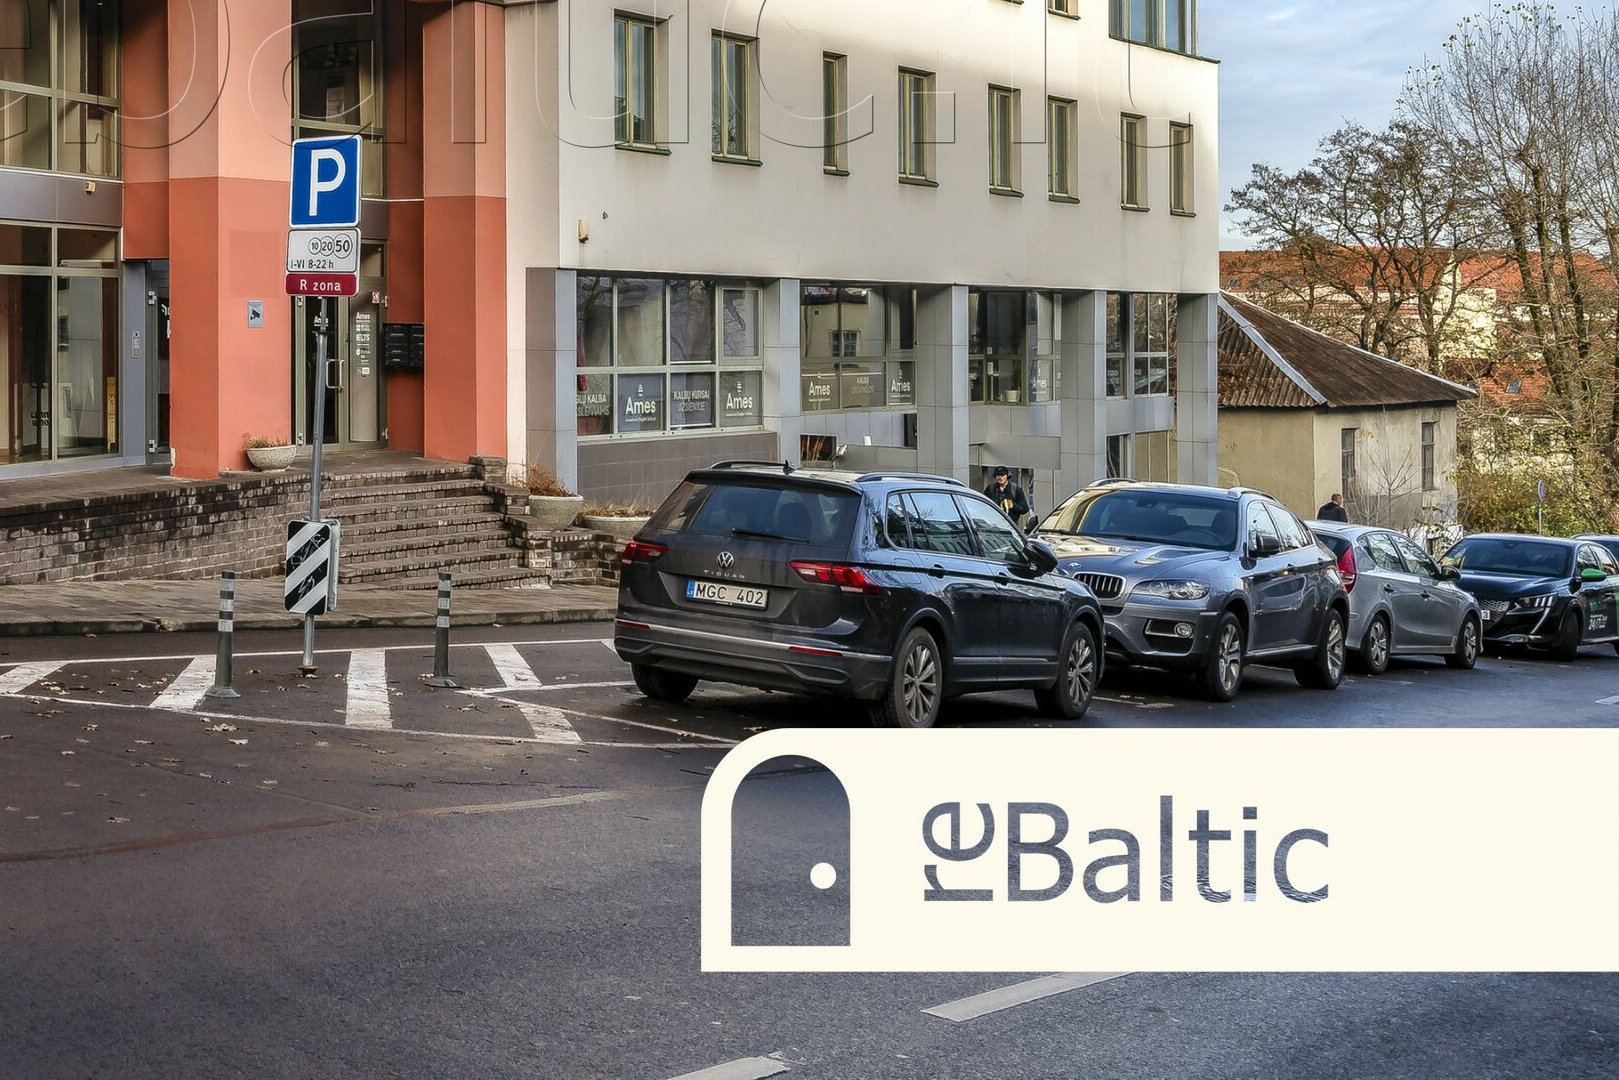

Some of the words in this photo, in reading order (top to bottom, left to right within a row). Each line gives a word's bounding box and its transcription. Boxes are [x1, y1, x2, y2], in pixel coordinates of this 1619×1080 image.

[309, 148, 346, 216] P
[311, 242, 319, 251] 10
[322, 241, 333, 251] 20
[335, 240, 350, 252] 50
[291, 260, 305, 269] I-VI
[308, 260, 327, 269] 8-22
[329, 260, 334, 268] h
[300, 279, 307, 290] R
[313, 282, 341, 291] zona
[356, 312, 370, 320] Ames
[809, 381, 831, 396] Ames
[891, 379, 911, 392] Ames
[588, 394, 607, 404] KALBA
[726, 393, 753, 410] Ames
[626, 397, 656, 415] Ames
[703, 569, 746, 579] TIGUAN
[696, 583, 727, 600] MGC
[736, 589, 764, 605] 402
